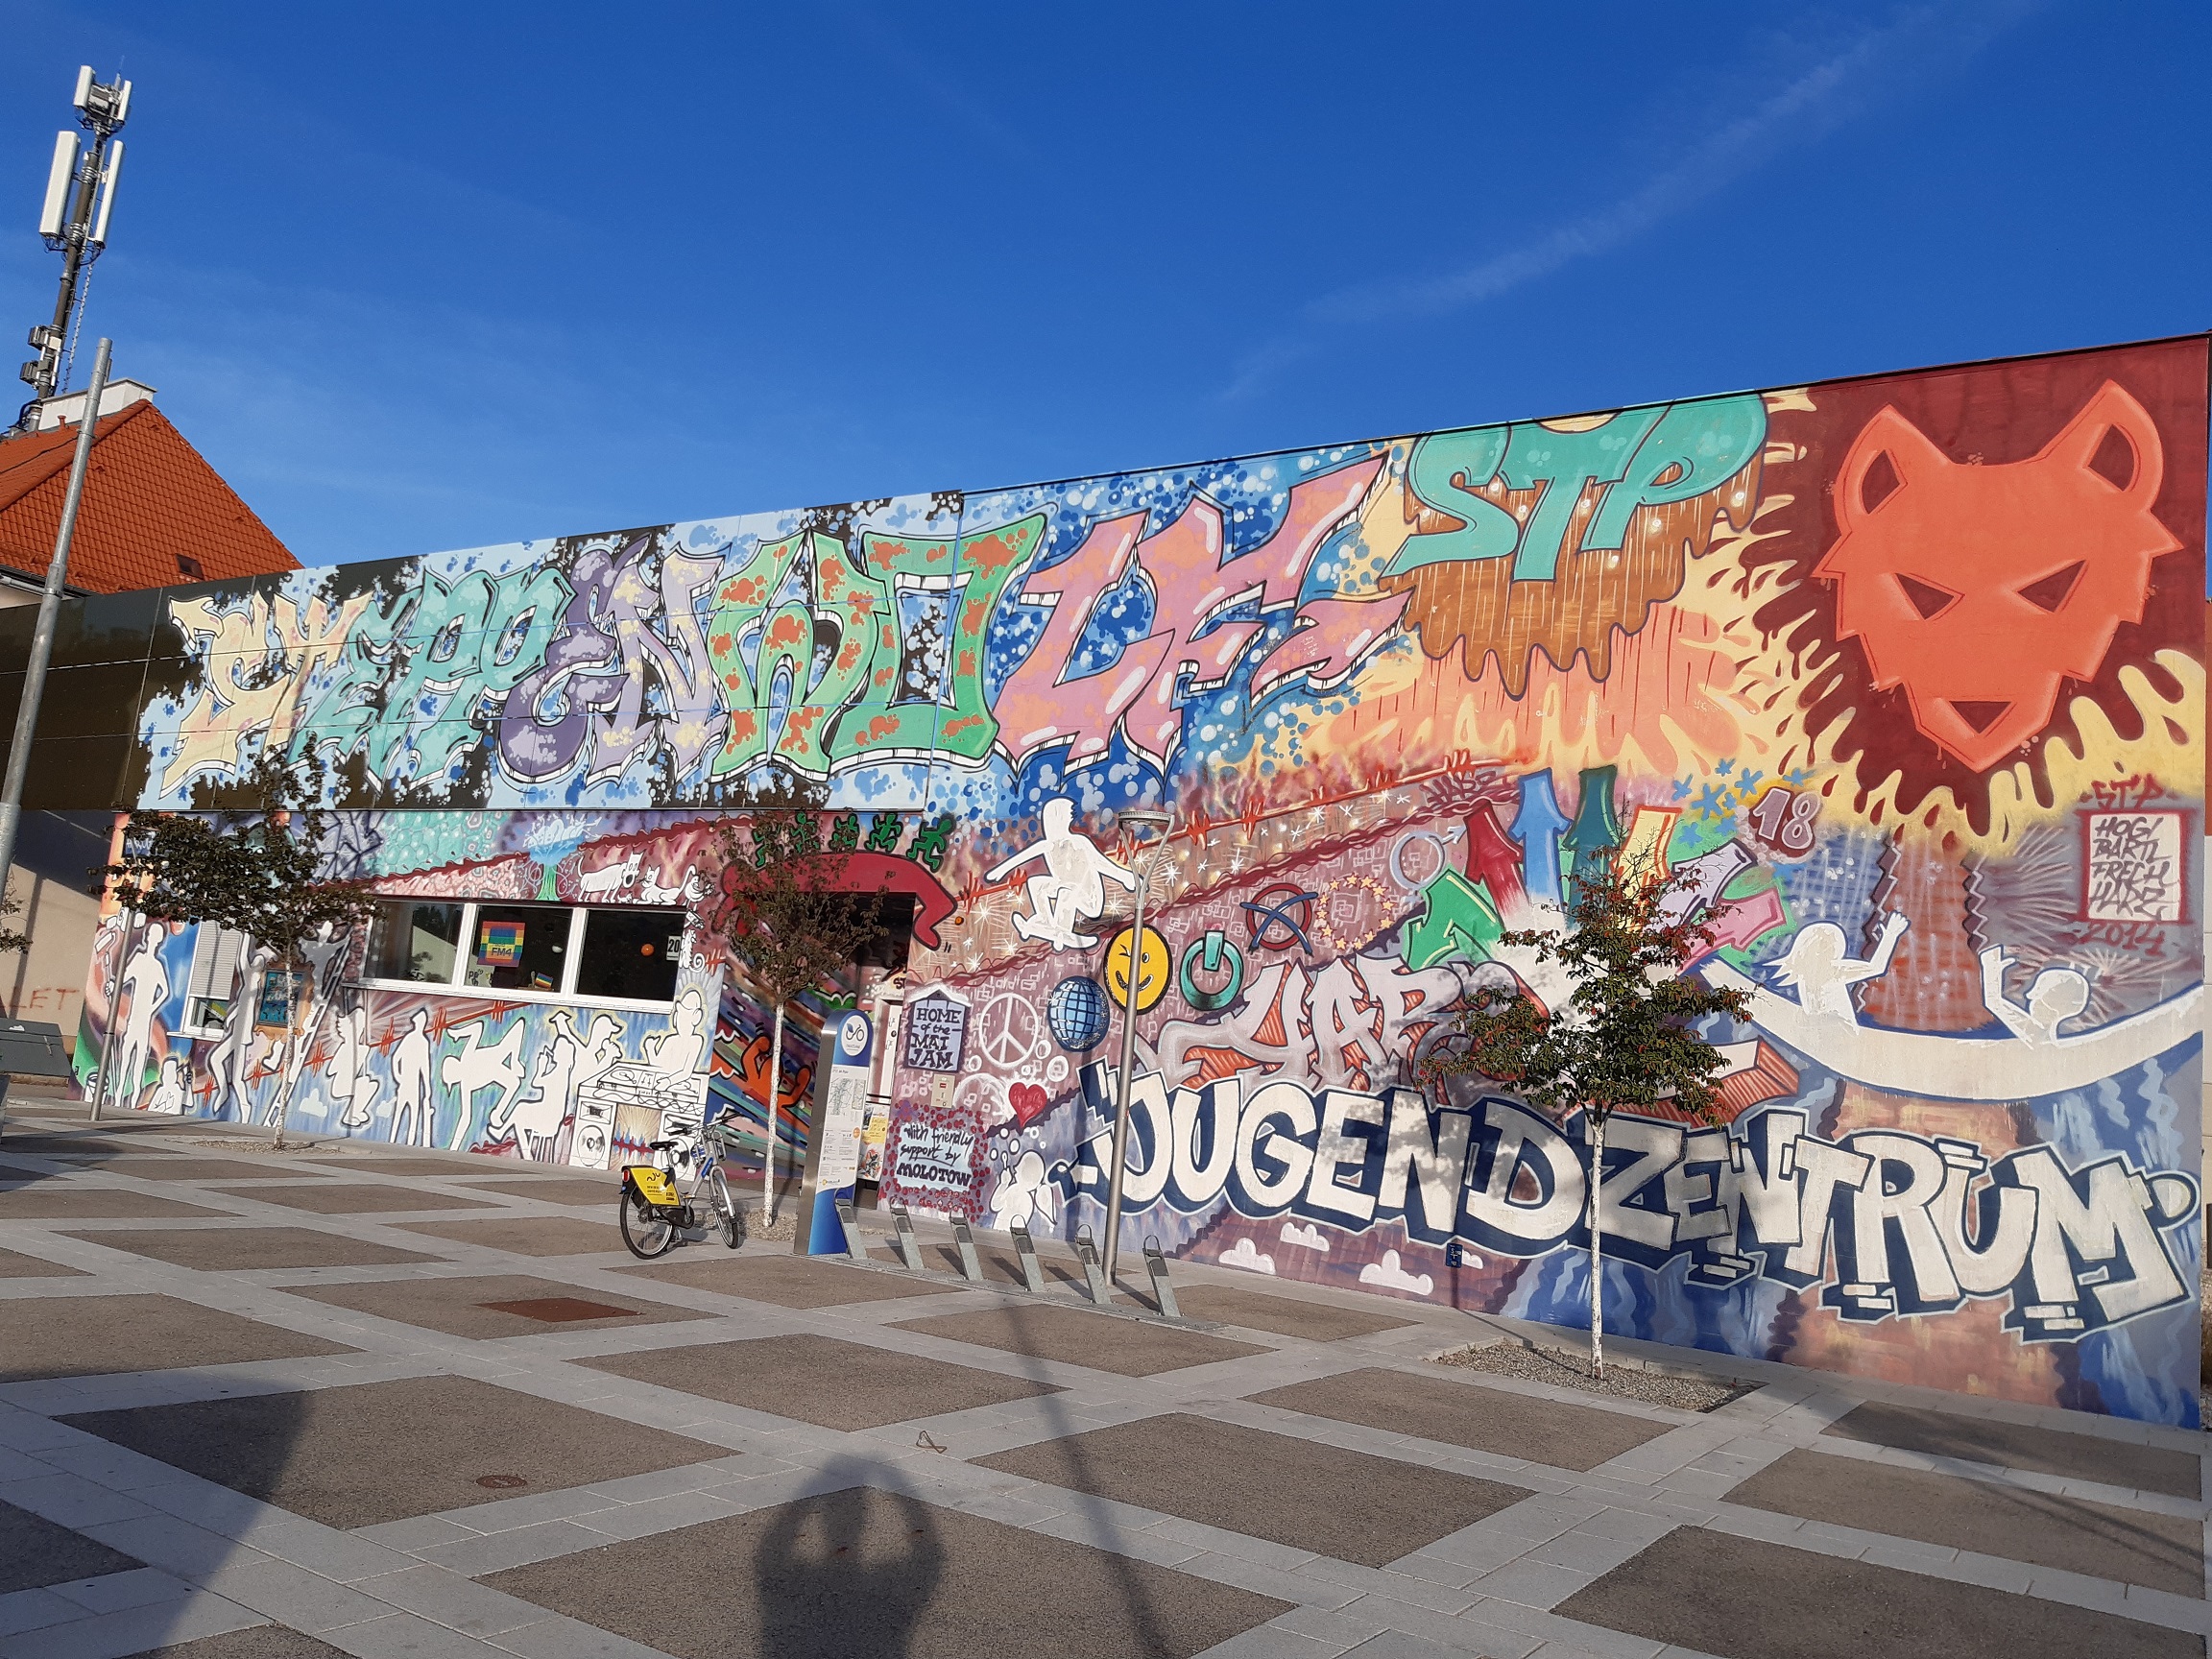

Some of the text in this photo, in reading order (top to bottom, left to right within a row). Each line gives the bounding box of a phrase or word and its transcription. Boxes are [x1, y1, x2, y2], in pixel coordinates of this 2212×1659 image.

[1379, 388, 1767, 582] STP
[1753, 788, 1820, 850] 18
[491, 947, 513, 957] FM4
[916, 1007, 962, 1024] HOME
[921, 1023, 950, 1035] of the
[909, 1048, 953, 1070] JAM
[931, 1127, 974, 1155] friendly
[901, 1143, 961, 1167] support by
[896, 1163, 973, 1187] MOLOTOW
[1070, 1070, 2187, 1323] JUGENDZENTRUM
